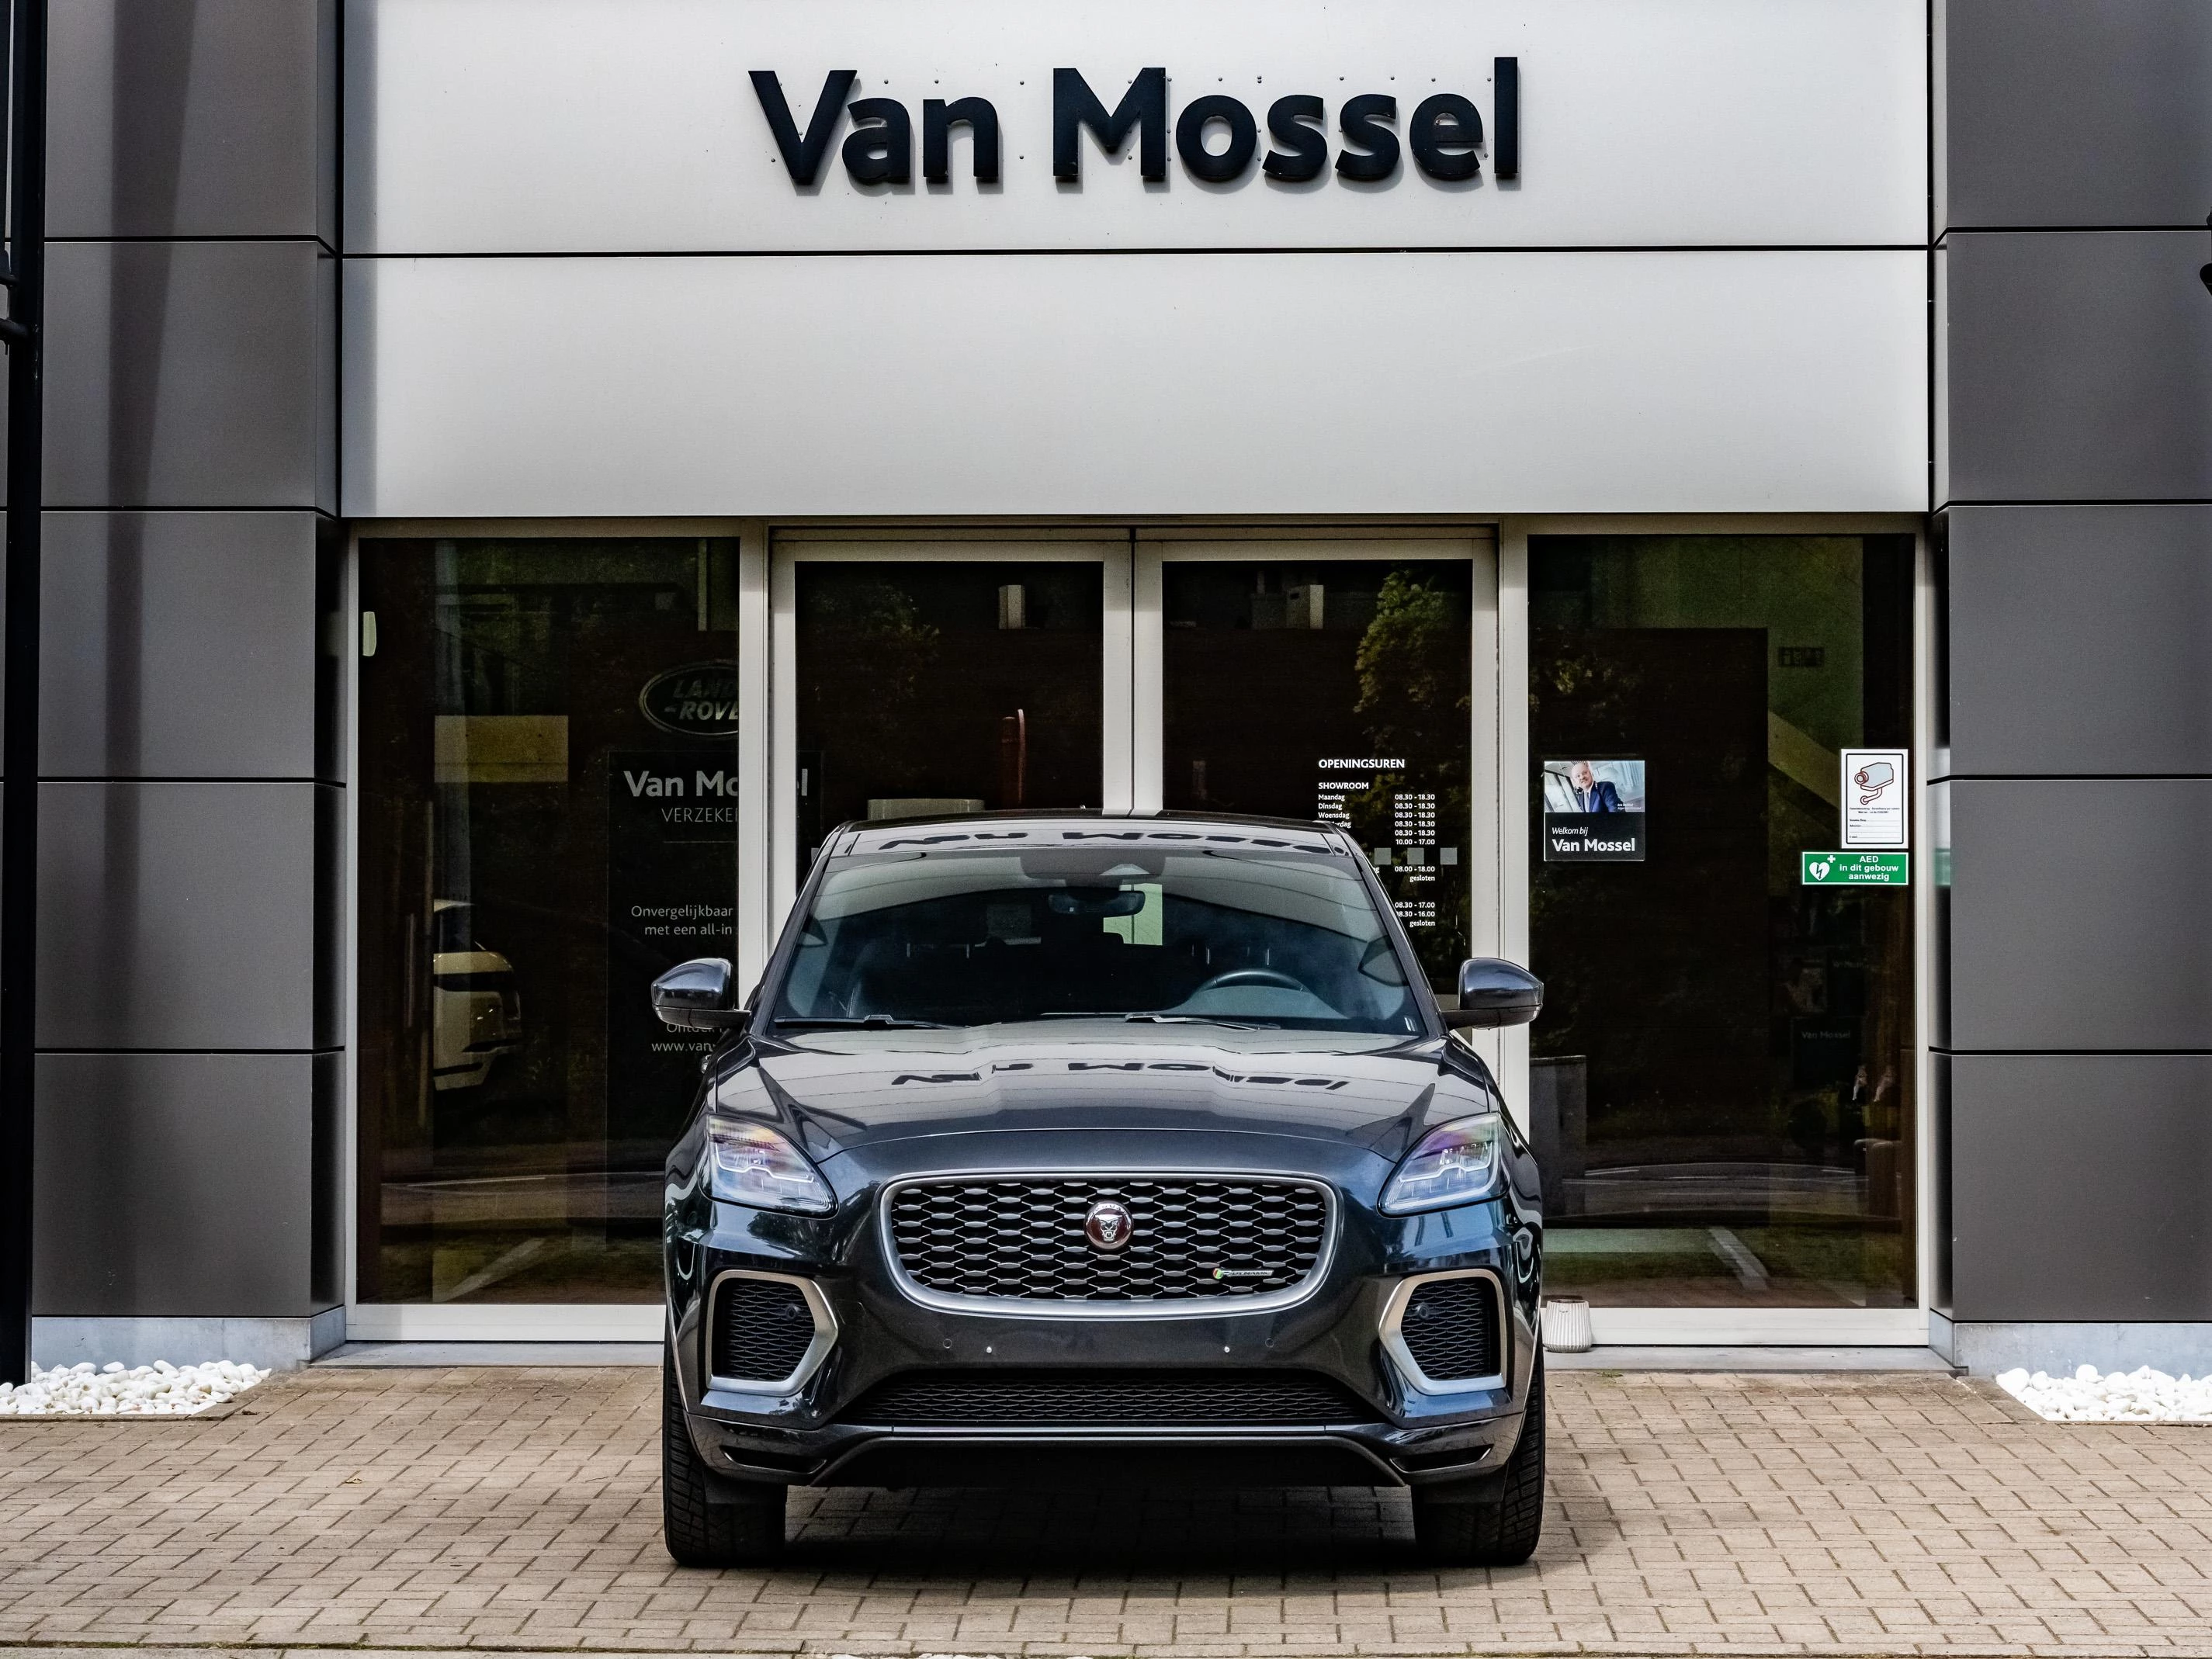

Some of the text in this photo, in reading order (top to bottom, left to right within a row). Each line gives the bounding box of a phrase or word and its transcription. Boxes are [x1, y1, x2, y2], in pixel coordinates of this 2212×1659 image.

[748, 57, 1519, 184] Van Mossel
[678, 700, 738, 721] ROVE
[1318, 758, 1406, 769] OPENINGSUREN
[623, 771, 684, 797] Van
[1318, 781, 1369, 790] SHOWROOM
[1318, 802, 1343, 811] Dinsdag
[661, 807, 738, 823] VERZEKE
[1579, 826, 1589, 836] bij
[1552, 838, 1635, 852] Van Mossel
[1864, 864, 1899, 873] gebouw
[1849, 873, 1890, 881] aanwezig
[631, 905, 733, 920] Onvergelijkbaar
[644, 923, 733, 936] met een all-in
